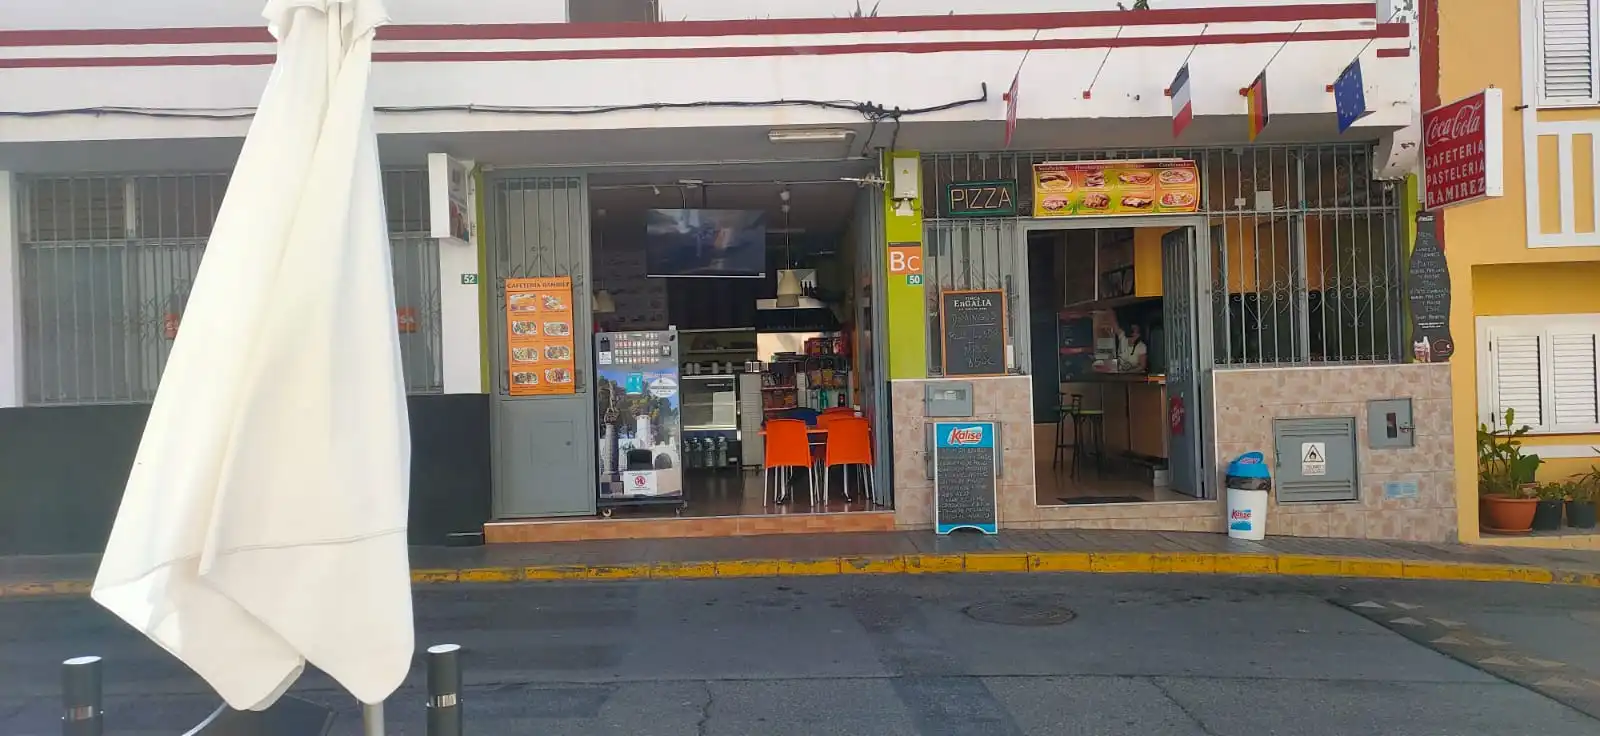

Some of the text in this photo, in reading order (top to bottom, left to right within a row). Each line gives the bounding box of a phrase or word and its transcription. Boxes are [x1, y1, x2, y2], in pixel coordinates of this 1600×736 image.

[1425, 140, 1485, 169] CAFETERIA
[1426, 159, 1485, 187] PASTELERIA
[950, 187, 1012, 209] PIZZA
[1427, 178, 1485, 207] RAMIREZ
[463, 274, 474, 283] 52
[909, 276, 920, 284] 50
[950, 428, 982, 444] Kalise
